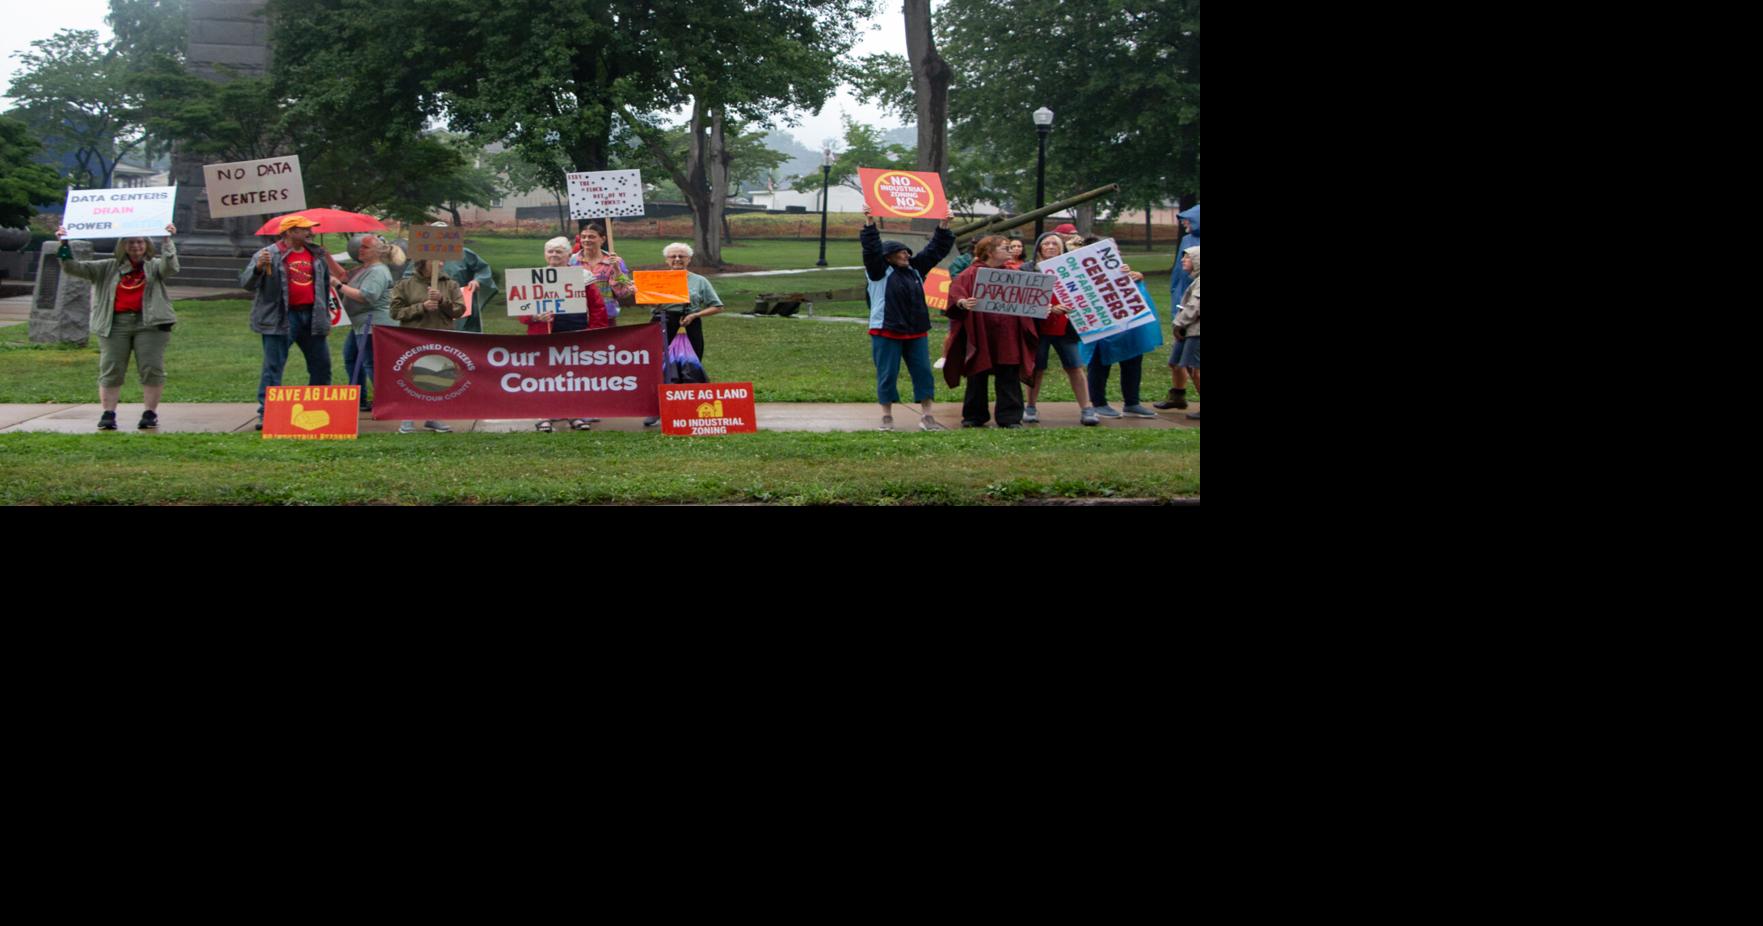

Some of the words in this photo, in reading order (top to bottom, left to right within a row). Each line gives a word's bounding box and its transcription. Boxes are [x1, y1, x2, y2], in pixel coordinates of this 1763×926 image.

[217, 168, 245, 180] NO
[257, 162, 292, 176] DATA
[890, 176, 910, 186] NO
[880, 184, 926, 193] INDUSTRIAL
[71, 194, 106, 203] DATA
[110, 192, 168, 201] CENTERS
[221, 188, 289, 207] CENTERS
[896, 198, 915, 207] NO
[93, 207, 134, 215] DRAIN
[67, 222, 112, 230] POWER
[531, 268, 558, 284] NO
[1025, 275, 1048, 287] LET
[1098, 246, 1121, 270] NO
[1114, 275, 1146, 315] DATA
[508, 285, 528, 301] AI
[1066, 256, 1080, 271] ON
[1074, 273, 1113, 326] FARMLAND
[1081, 256, 1129, 321] CENTERS
[1056, 266, 1070, 279] OR
[1065, 281, 1079, 293] IN
[1074, 294, 1098, 327] RURAL
[1022, 304, 1037, 314] US
[393, 344, 442, 372] CONCERNED
[443, 345, 476, 371] CITIZENS
[487, 347, 540, 367] Our
[549, 345, 650, 366] Mission
[500, 371, 638, 393] Continues
[268, 388, 301, 401] SAVE
[304, 387, 320, 400] AG
[323, 387, 357, 400] LAND
[666, 391, 695, 400] SAVE
[698, 390, 713, 399] AG
[716, 389, 748, 399] LAND
[673, 420, 687, 428] NO
[688, 418, 744, 427] INDUSTRIAL
[691, 426, 727, 435] ZONING
